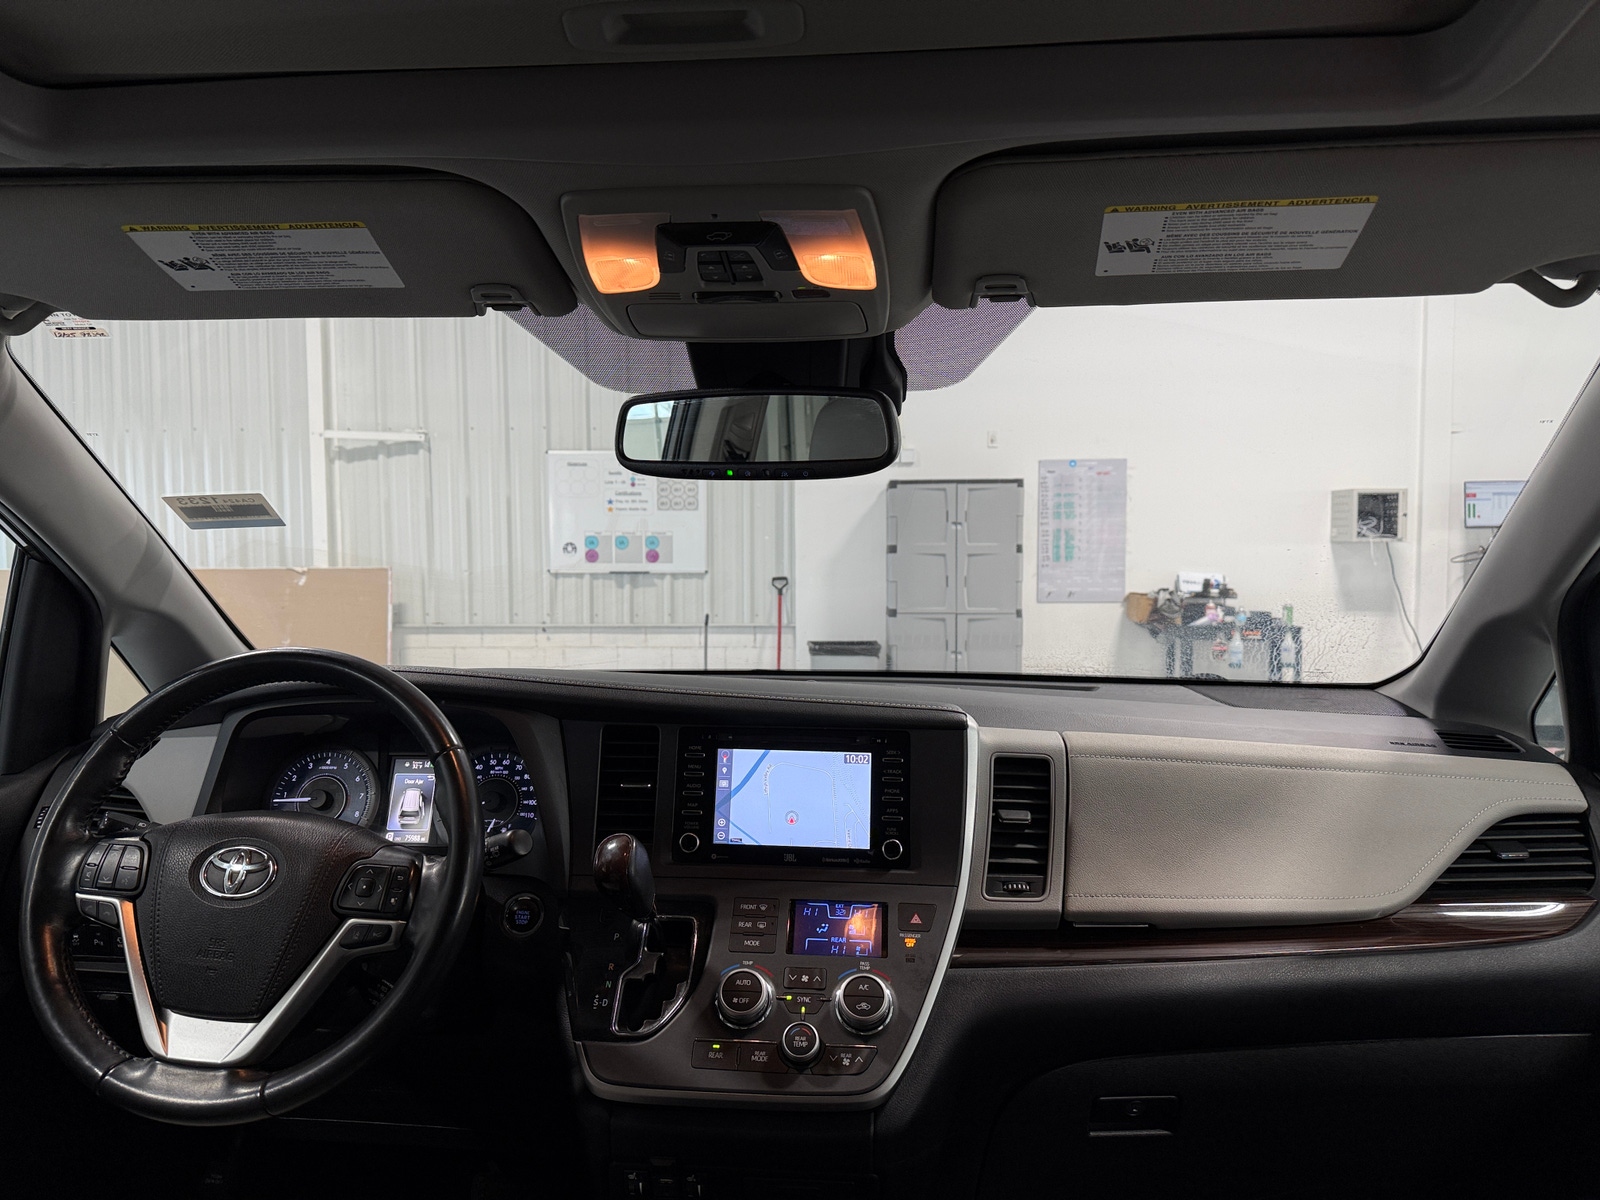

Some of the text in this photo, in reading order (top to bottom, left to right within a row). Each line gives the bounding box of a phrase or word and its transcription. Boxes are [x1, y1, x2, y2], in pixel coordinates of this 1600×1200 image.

[1124, 197, 1370, 214] WARNING AVERTISSEMENT ADVERTENCIA
[197, 223, 280, 231] AVERTISSEMENT
[288, 221, 361, 230] ADVERTENCIA
[845, 754, 869, 764] 10:02
[291, 774, 298, 782] 2
[355, 775, 361, 783] 6
[784, 854, 797, 862] JBL
[614, 932, 620, 941] P
[593, 998, 608, 1007] S D
[708, 1051, 723, 1059] REAR
